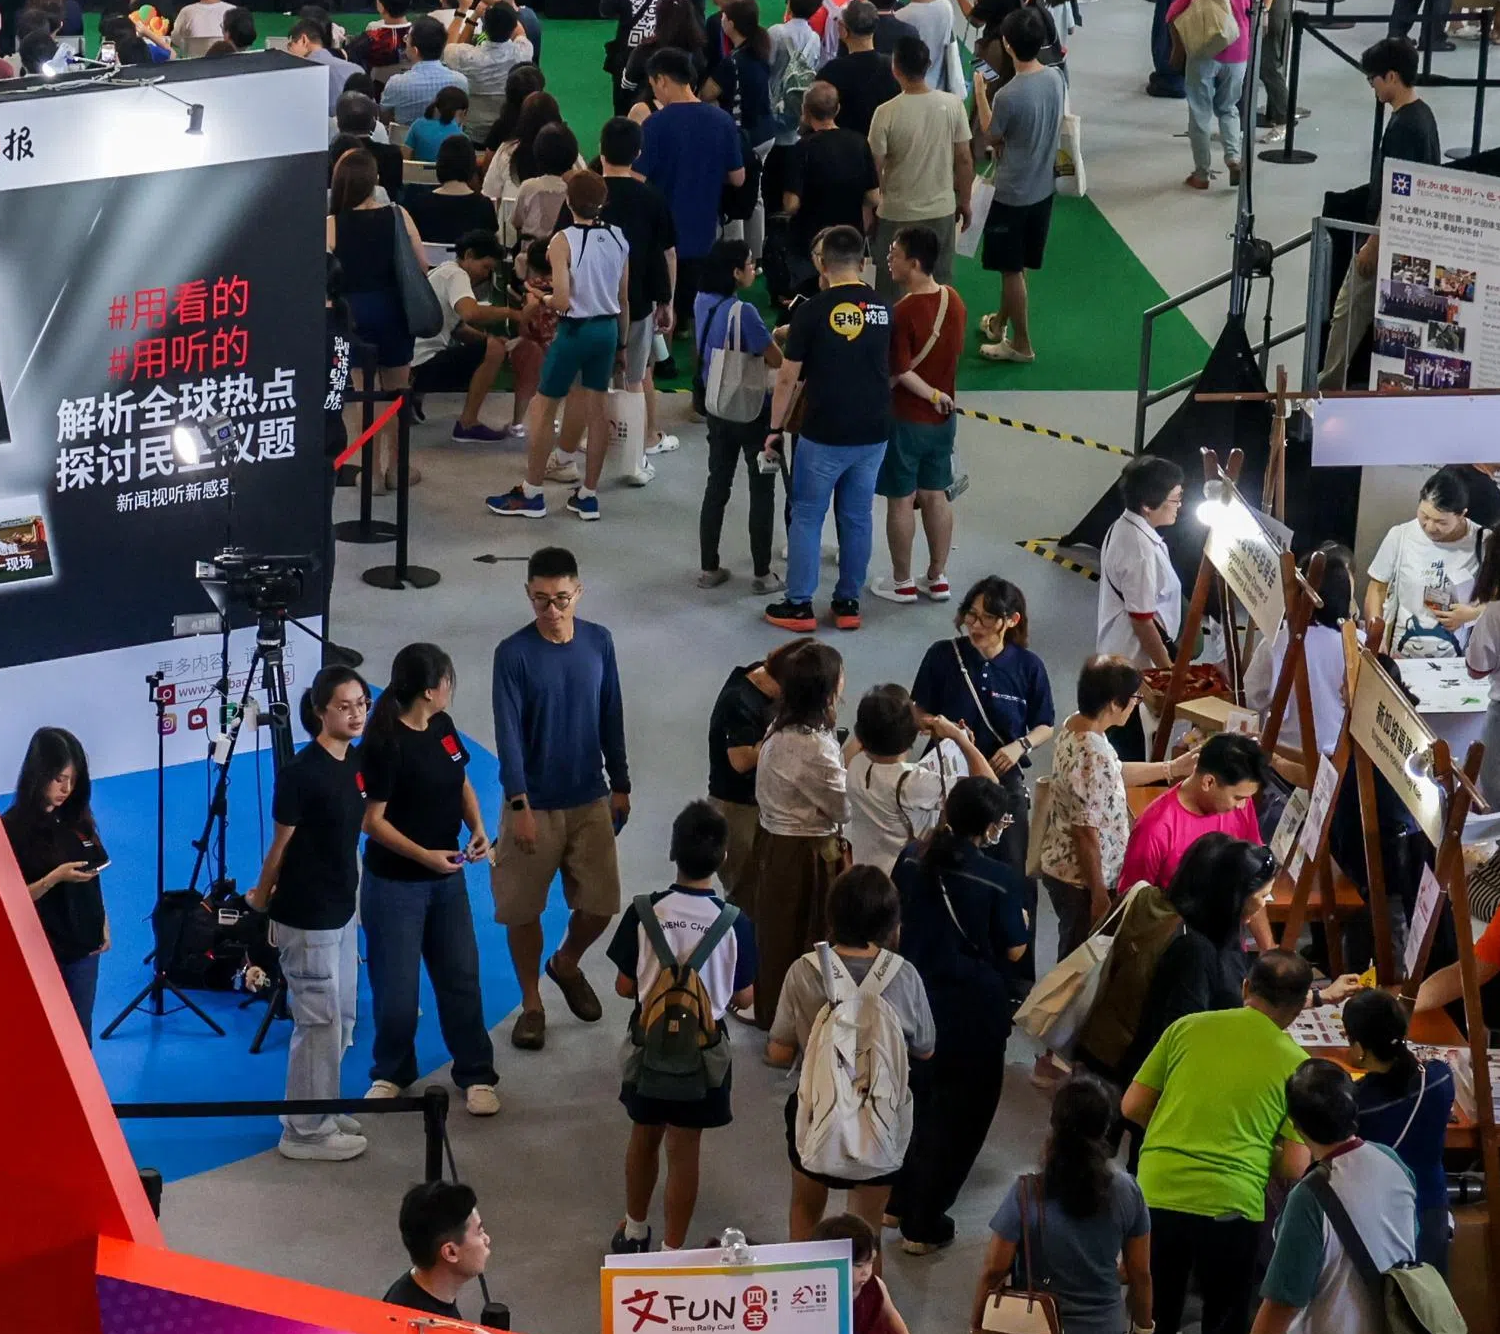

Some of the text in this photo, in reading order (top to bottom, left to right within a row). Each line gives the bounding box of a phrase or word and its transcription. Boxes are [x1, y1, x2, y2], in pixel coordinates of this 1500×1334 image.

[107, 274, 250, 331] #用看的
[107, 326, 250, 382] #用听的
[56, 367, 298, 451] 解析全球热点
[671, 1320, 736, 1334] Stamp Rally Card
